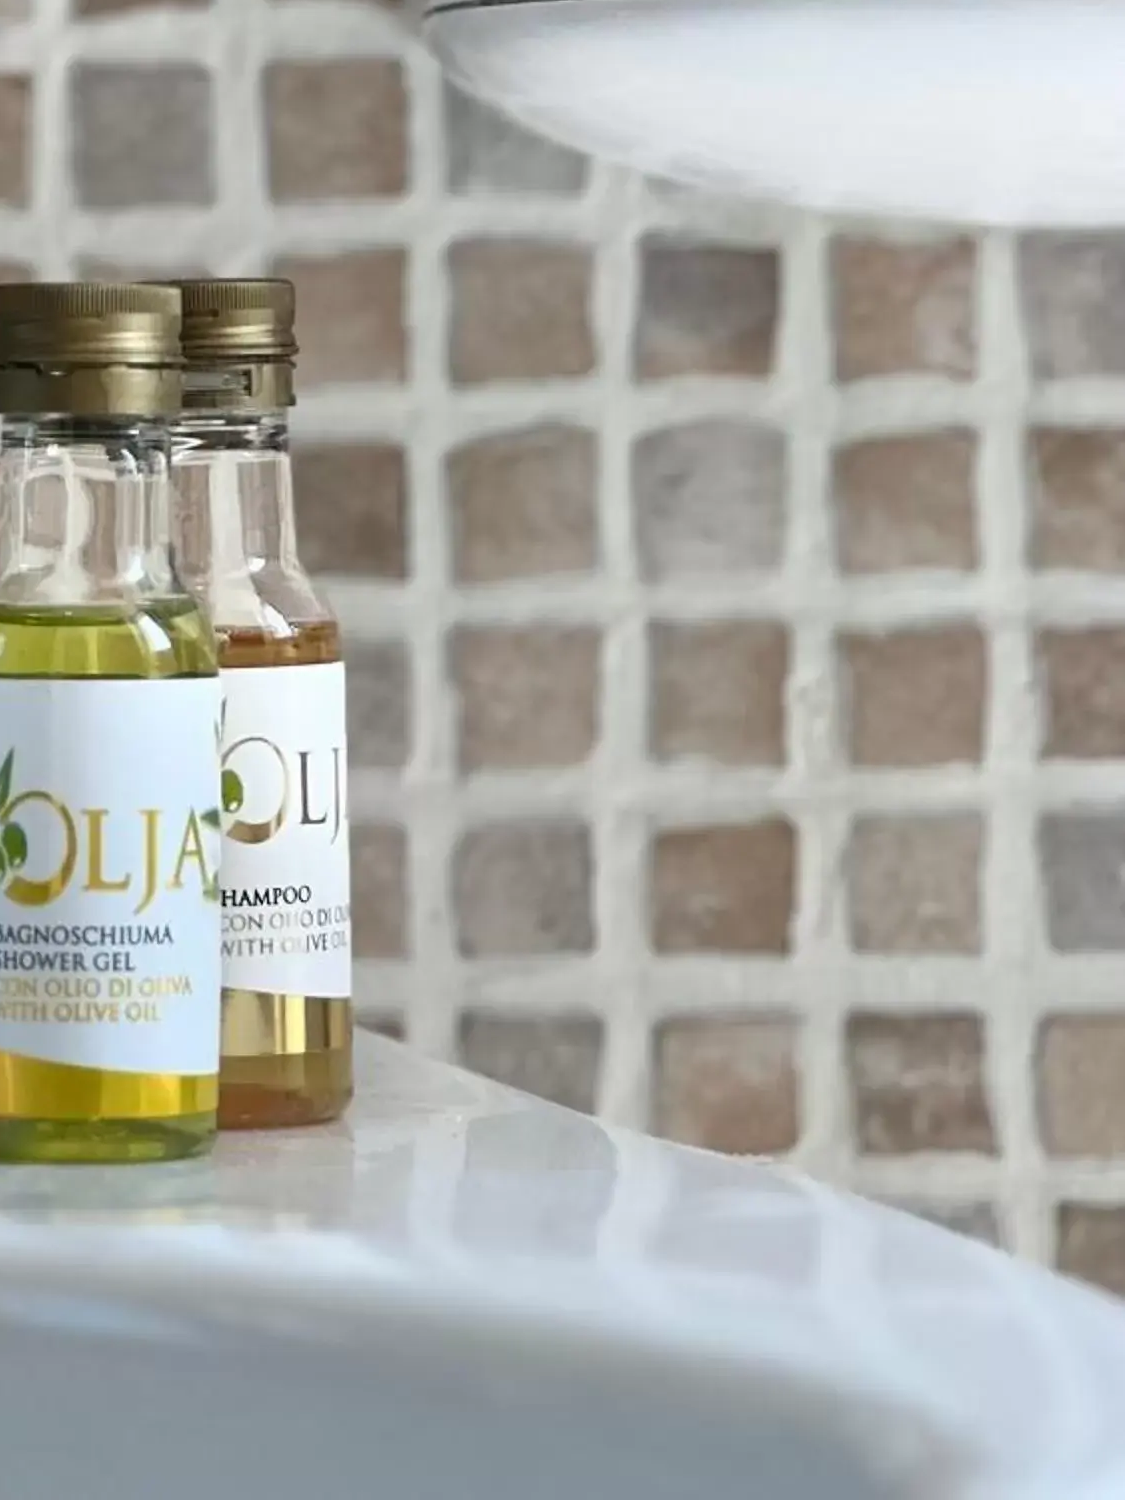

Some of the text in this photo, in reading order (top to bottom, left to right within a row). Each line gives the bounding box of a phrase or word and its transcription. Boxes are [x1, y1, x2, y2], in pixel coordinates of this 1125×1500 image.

[221, 736, 347, 845] OLJ
[0, 789, 218, 915] OLJA
[220, 884, 312, 907] HAMPOO
[93, 952, 136, 971] GEL
[44, 977, 101, 998] OLIO
[109, 978, 132, 997] DI
[54, 1002, 120, 1022] OLIVE
[125, 1001, 161, 1022] OIL
